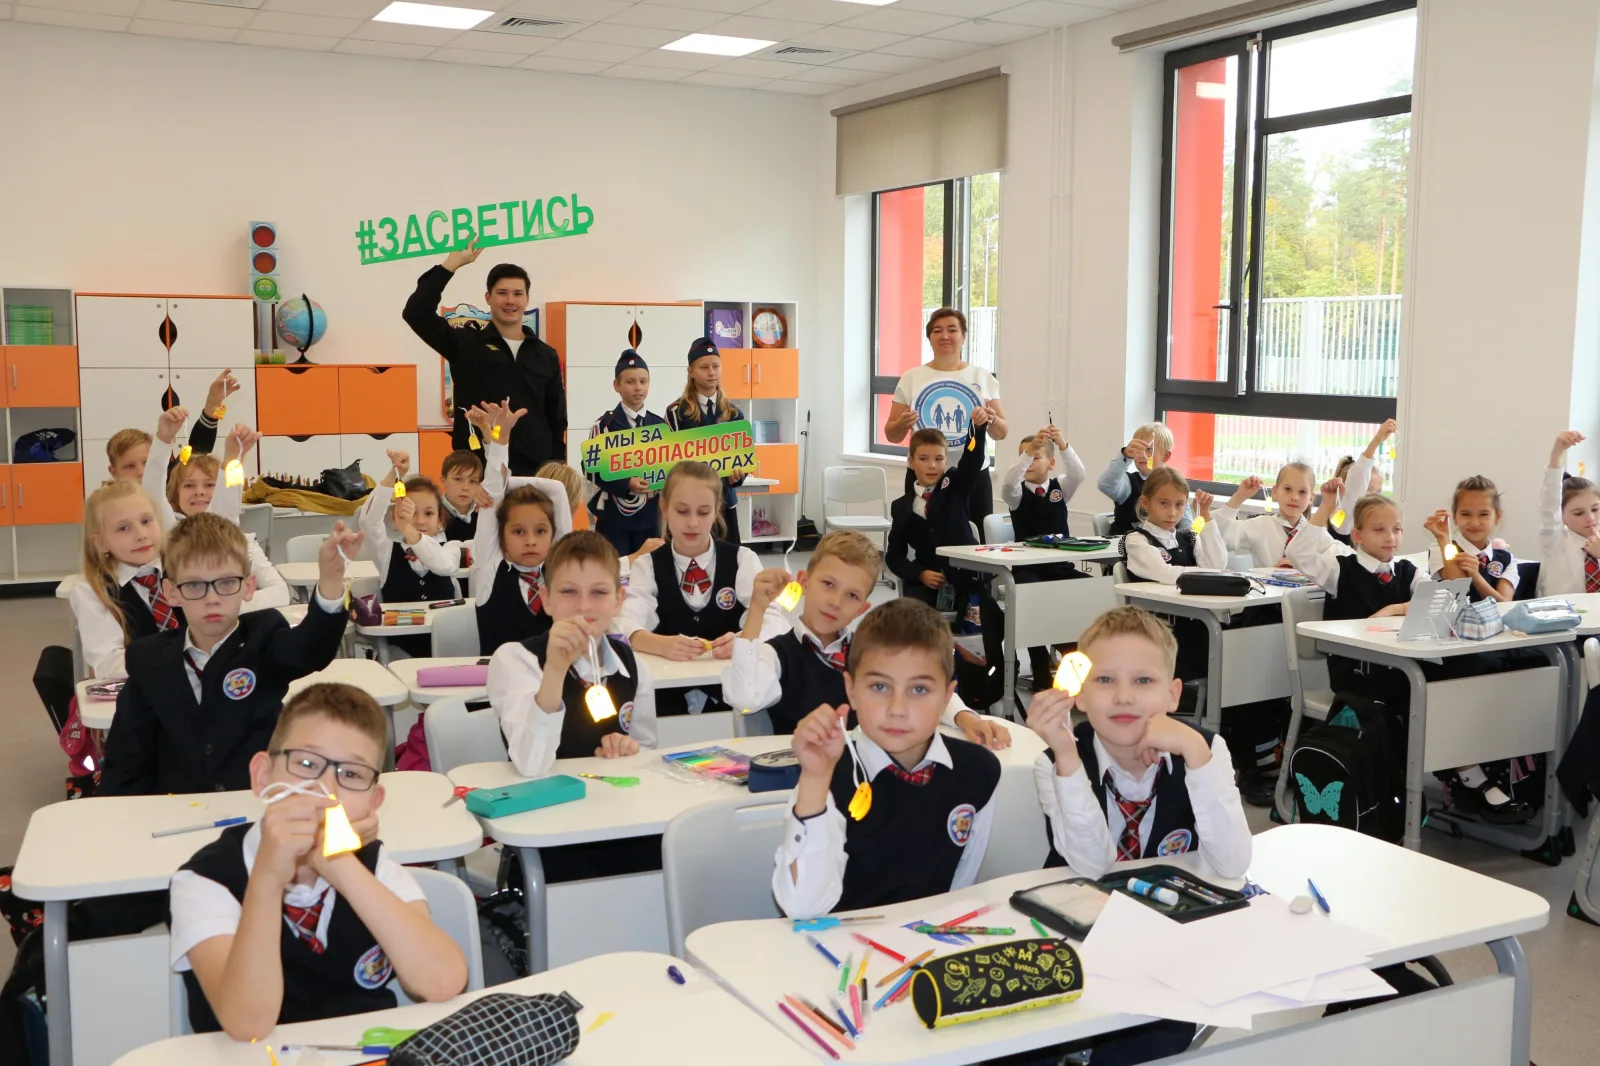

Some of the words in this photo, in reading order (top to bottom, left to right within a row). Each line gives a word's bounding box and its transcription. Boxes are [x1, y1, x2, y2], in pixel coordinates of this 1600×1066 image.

[355, 193, 594, 264] #ЗАСВЕТИСЬ
[604, 431, 635, 450] МЫ
[640, 427, 663, 443] ЗА
[609, 431, 753, 473] БЕЗОПАСНОСТЬ
[643, 468, 667, 484] НА
